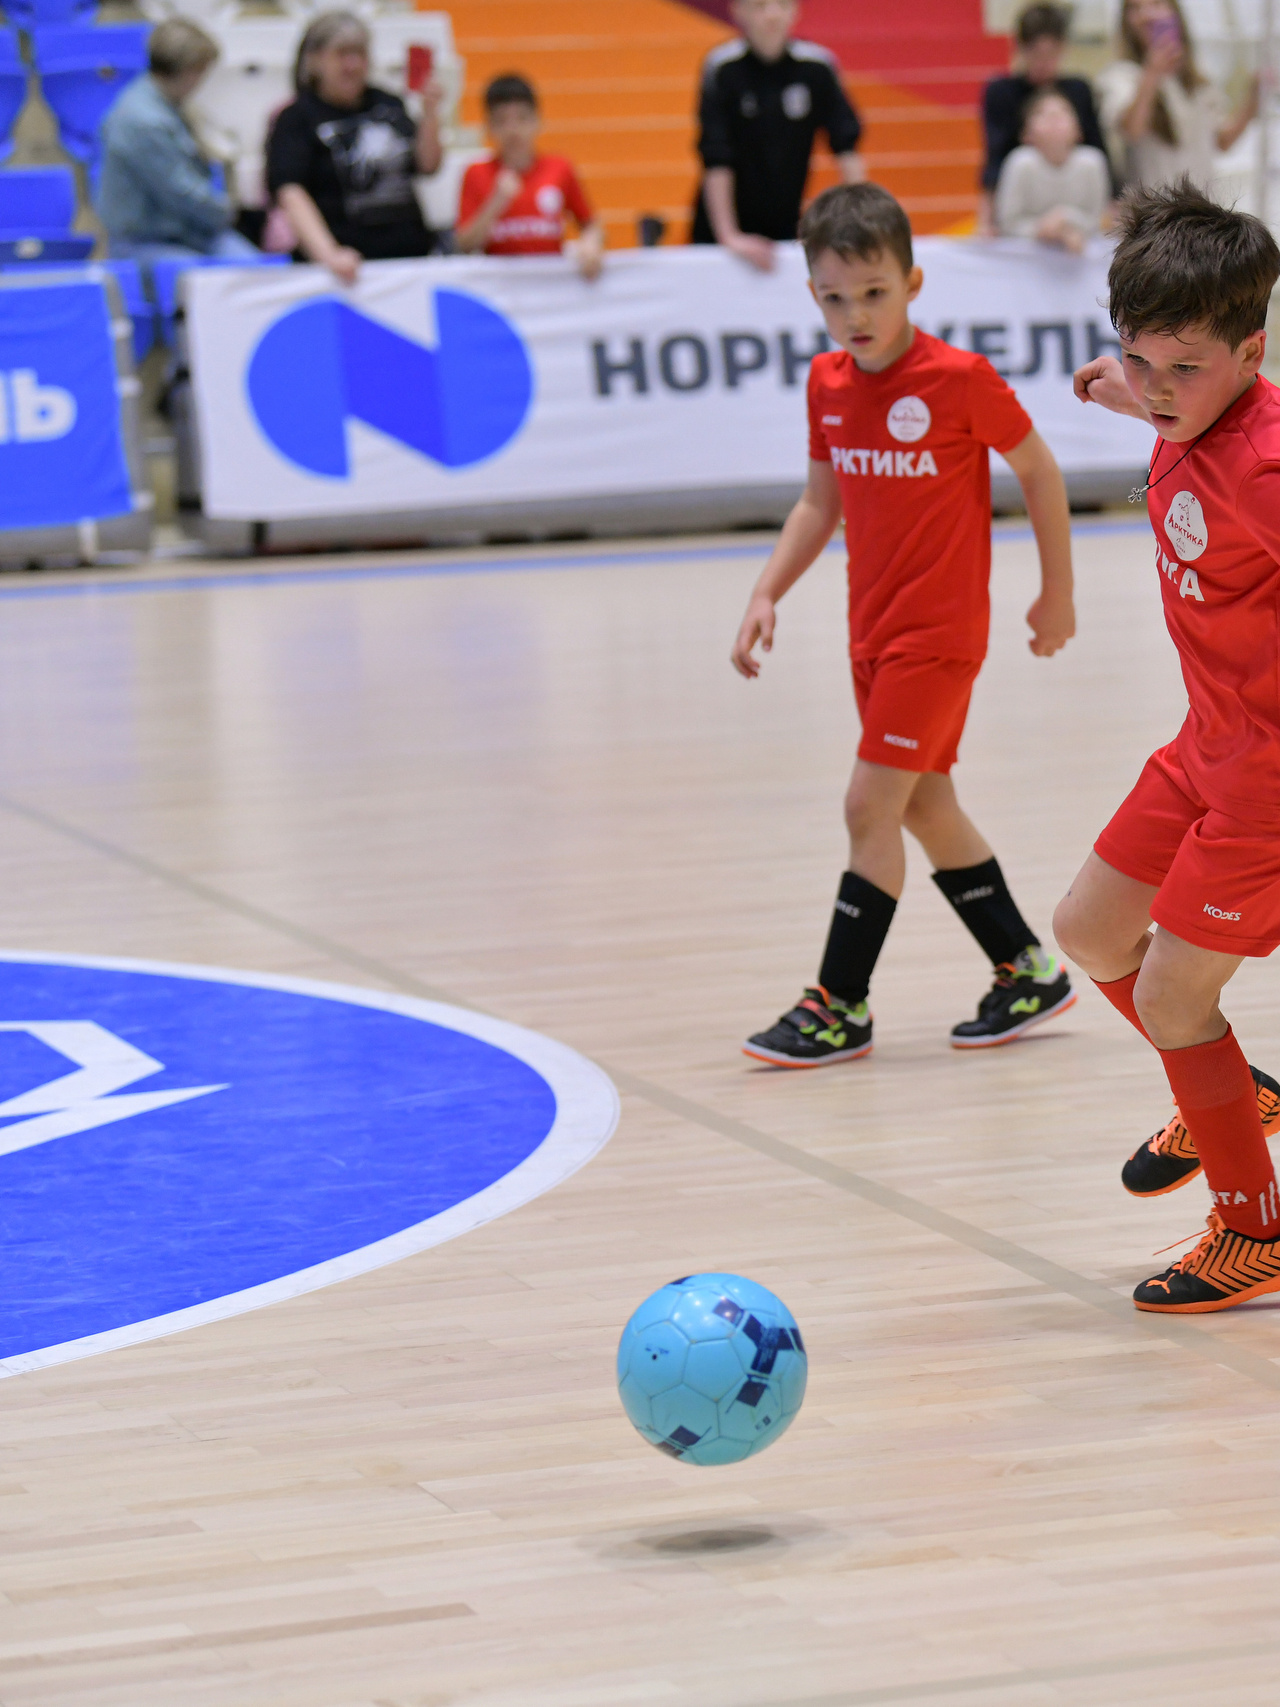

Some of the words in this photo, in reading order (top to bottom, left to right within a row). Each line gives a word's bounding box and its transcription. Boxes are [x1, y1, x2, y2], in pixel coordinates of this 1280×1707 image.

[592, 318, 1123, 396] НОРНЕЛ
[1168, 513, 1204, 547] АРКТИКА
[1203, 903, 1242, 921] KODES
